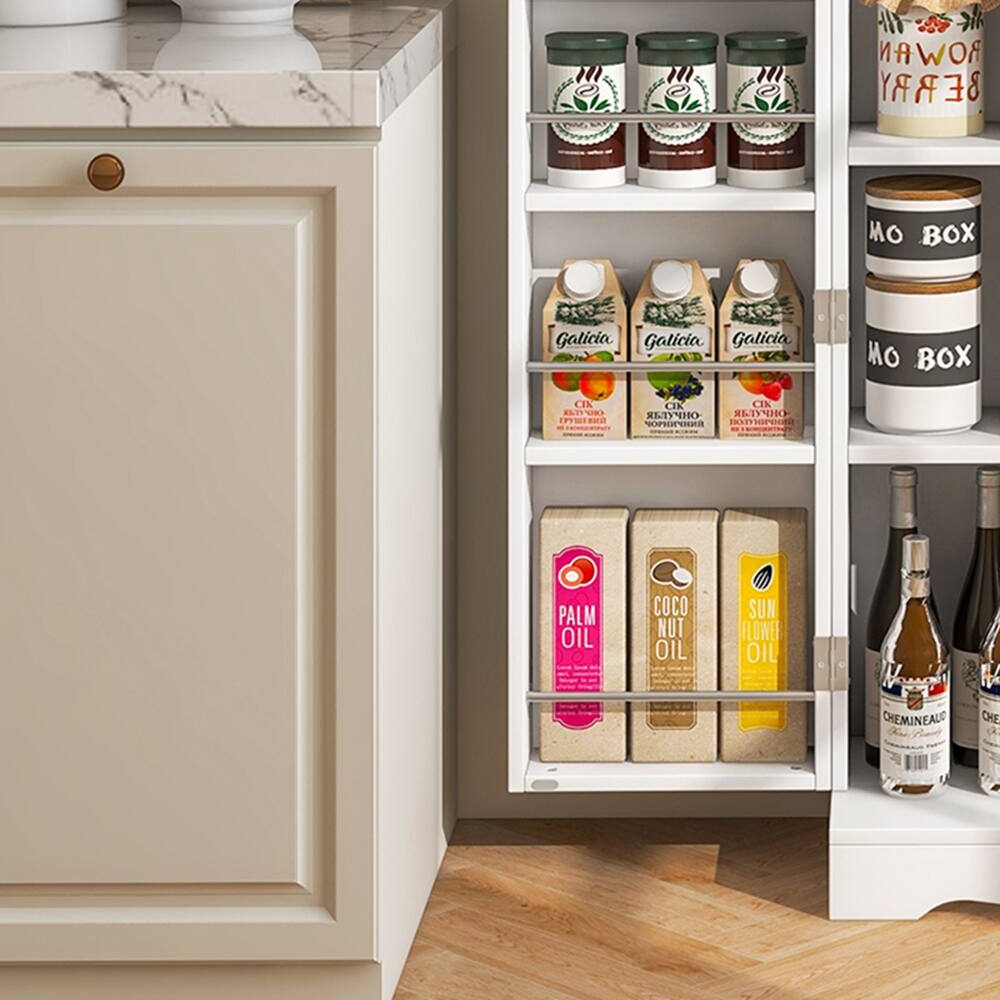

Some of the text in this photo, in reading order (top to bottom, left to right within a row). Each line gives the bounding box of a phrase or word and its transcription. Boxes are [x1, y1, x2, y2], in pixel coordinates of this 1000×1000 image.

[869, 221, 976, 247] MO BOX
[556, 331, 613, 349] Galicia
[644, 333, 704, 351] Galicia
[732, 331, 792, 349] Galicia
[868, 341, 972, 372] MO BOX
[574, 400, 593, 408] СІК
[665, 402, 684, 410] СІК
[752, 400, 772, 408] СІК
[559, 605, 596, 626] PALM
[654, 596, 688, 617] COCO
[749, 598, 776, 620] SUN
[561, 627, 594, 649] OIL
[658, 617, 684, 638] NUT
[742, 620, 782, 641] FLOWER
[655, 639, 688, 660] OIL
[746, 642, 778, 664] OIL
[883, 710, 946, 726] CHEMINEAUD
